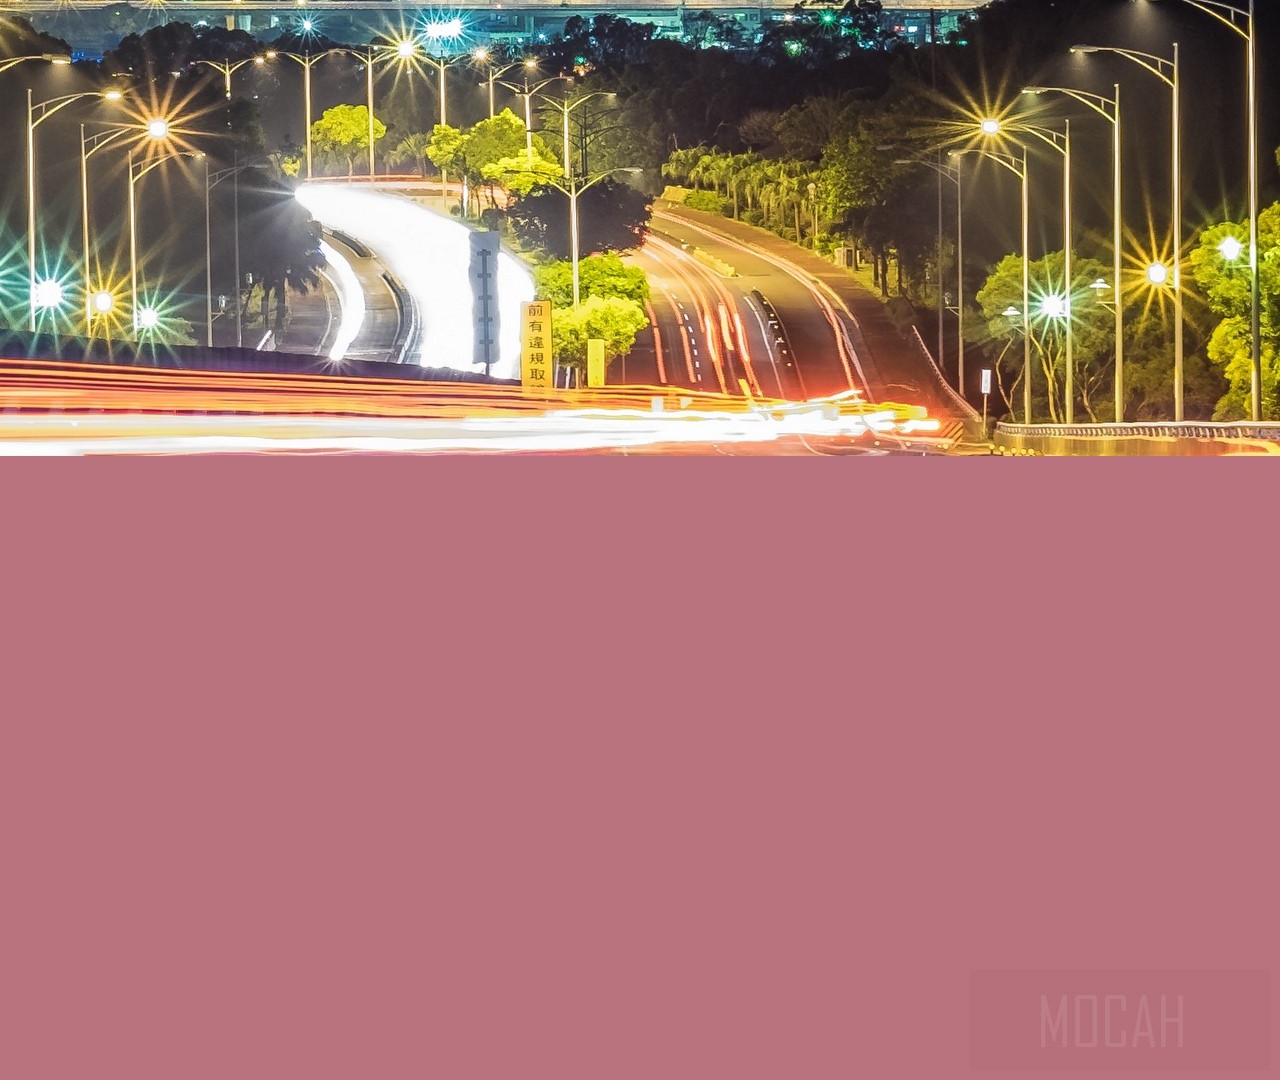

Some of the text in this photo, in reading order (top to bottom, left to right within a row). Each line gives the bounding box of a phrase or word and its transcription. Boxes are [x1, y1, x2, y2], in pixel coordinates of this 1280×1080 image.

[528, 304, 545, 388] 前有違規取
